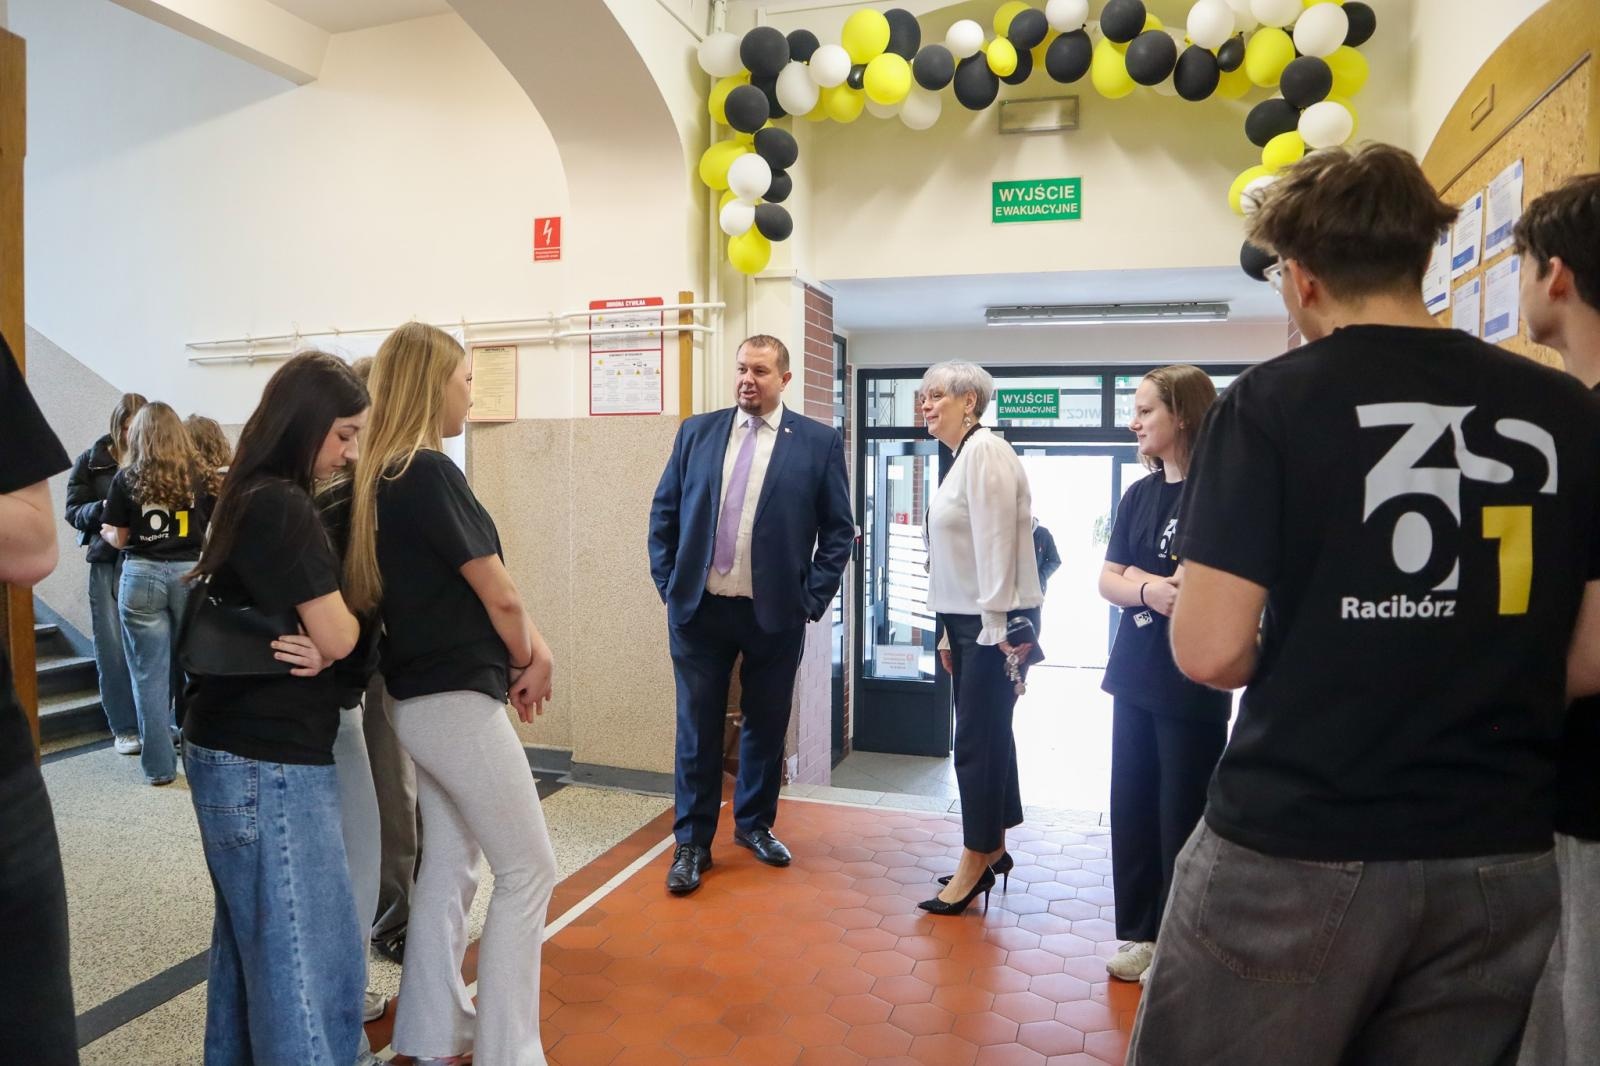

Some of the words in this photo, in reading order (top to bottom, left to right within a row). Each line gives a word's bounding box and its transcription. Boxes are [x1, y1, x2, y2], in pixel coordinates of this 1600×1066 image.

[999, 184, 1075, 202] WYJŚCIE
[995, 203, 1078, 216] EWAKUACYJNE
[1002, 392, 1054, 404] WYJŚCIE
[999, 406, 1057, 414] EWAKUACYJNE
[1341, 594, 1456, 619] Racibórz
